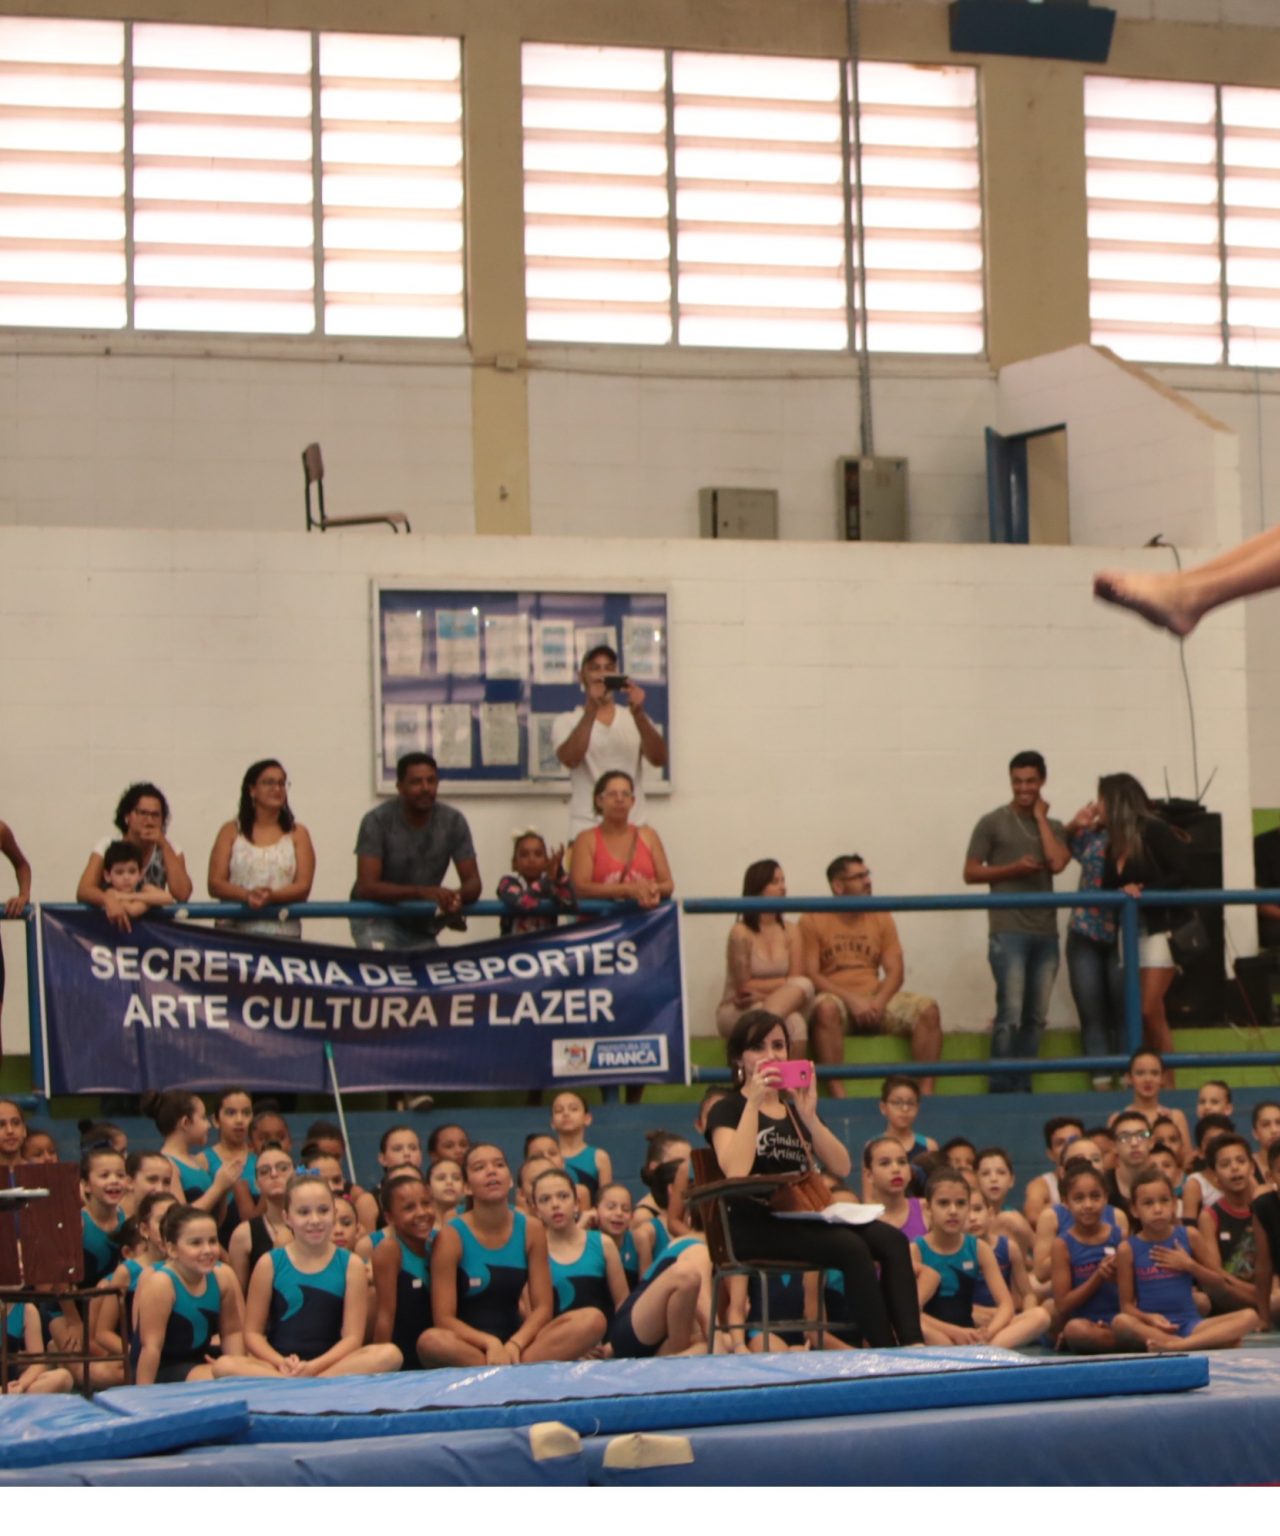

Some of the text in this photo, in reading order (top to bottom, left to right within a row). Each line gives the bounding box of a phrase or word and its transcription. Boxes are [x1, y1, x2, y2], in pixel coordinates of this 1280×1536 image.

[90, 940, 640, 987] SECRETARIA DE ESPORTES
[123, 987, 616, 1030] ARTE CULTURA E LAZER
[597, 1050, 658, 1067] FRANCA
